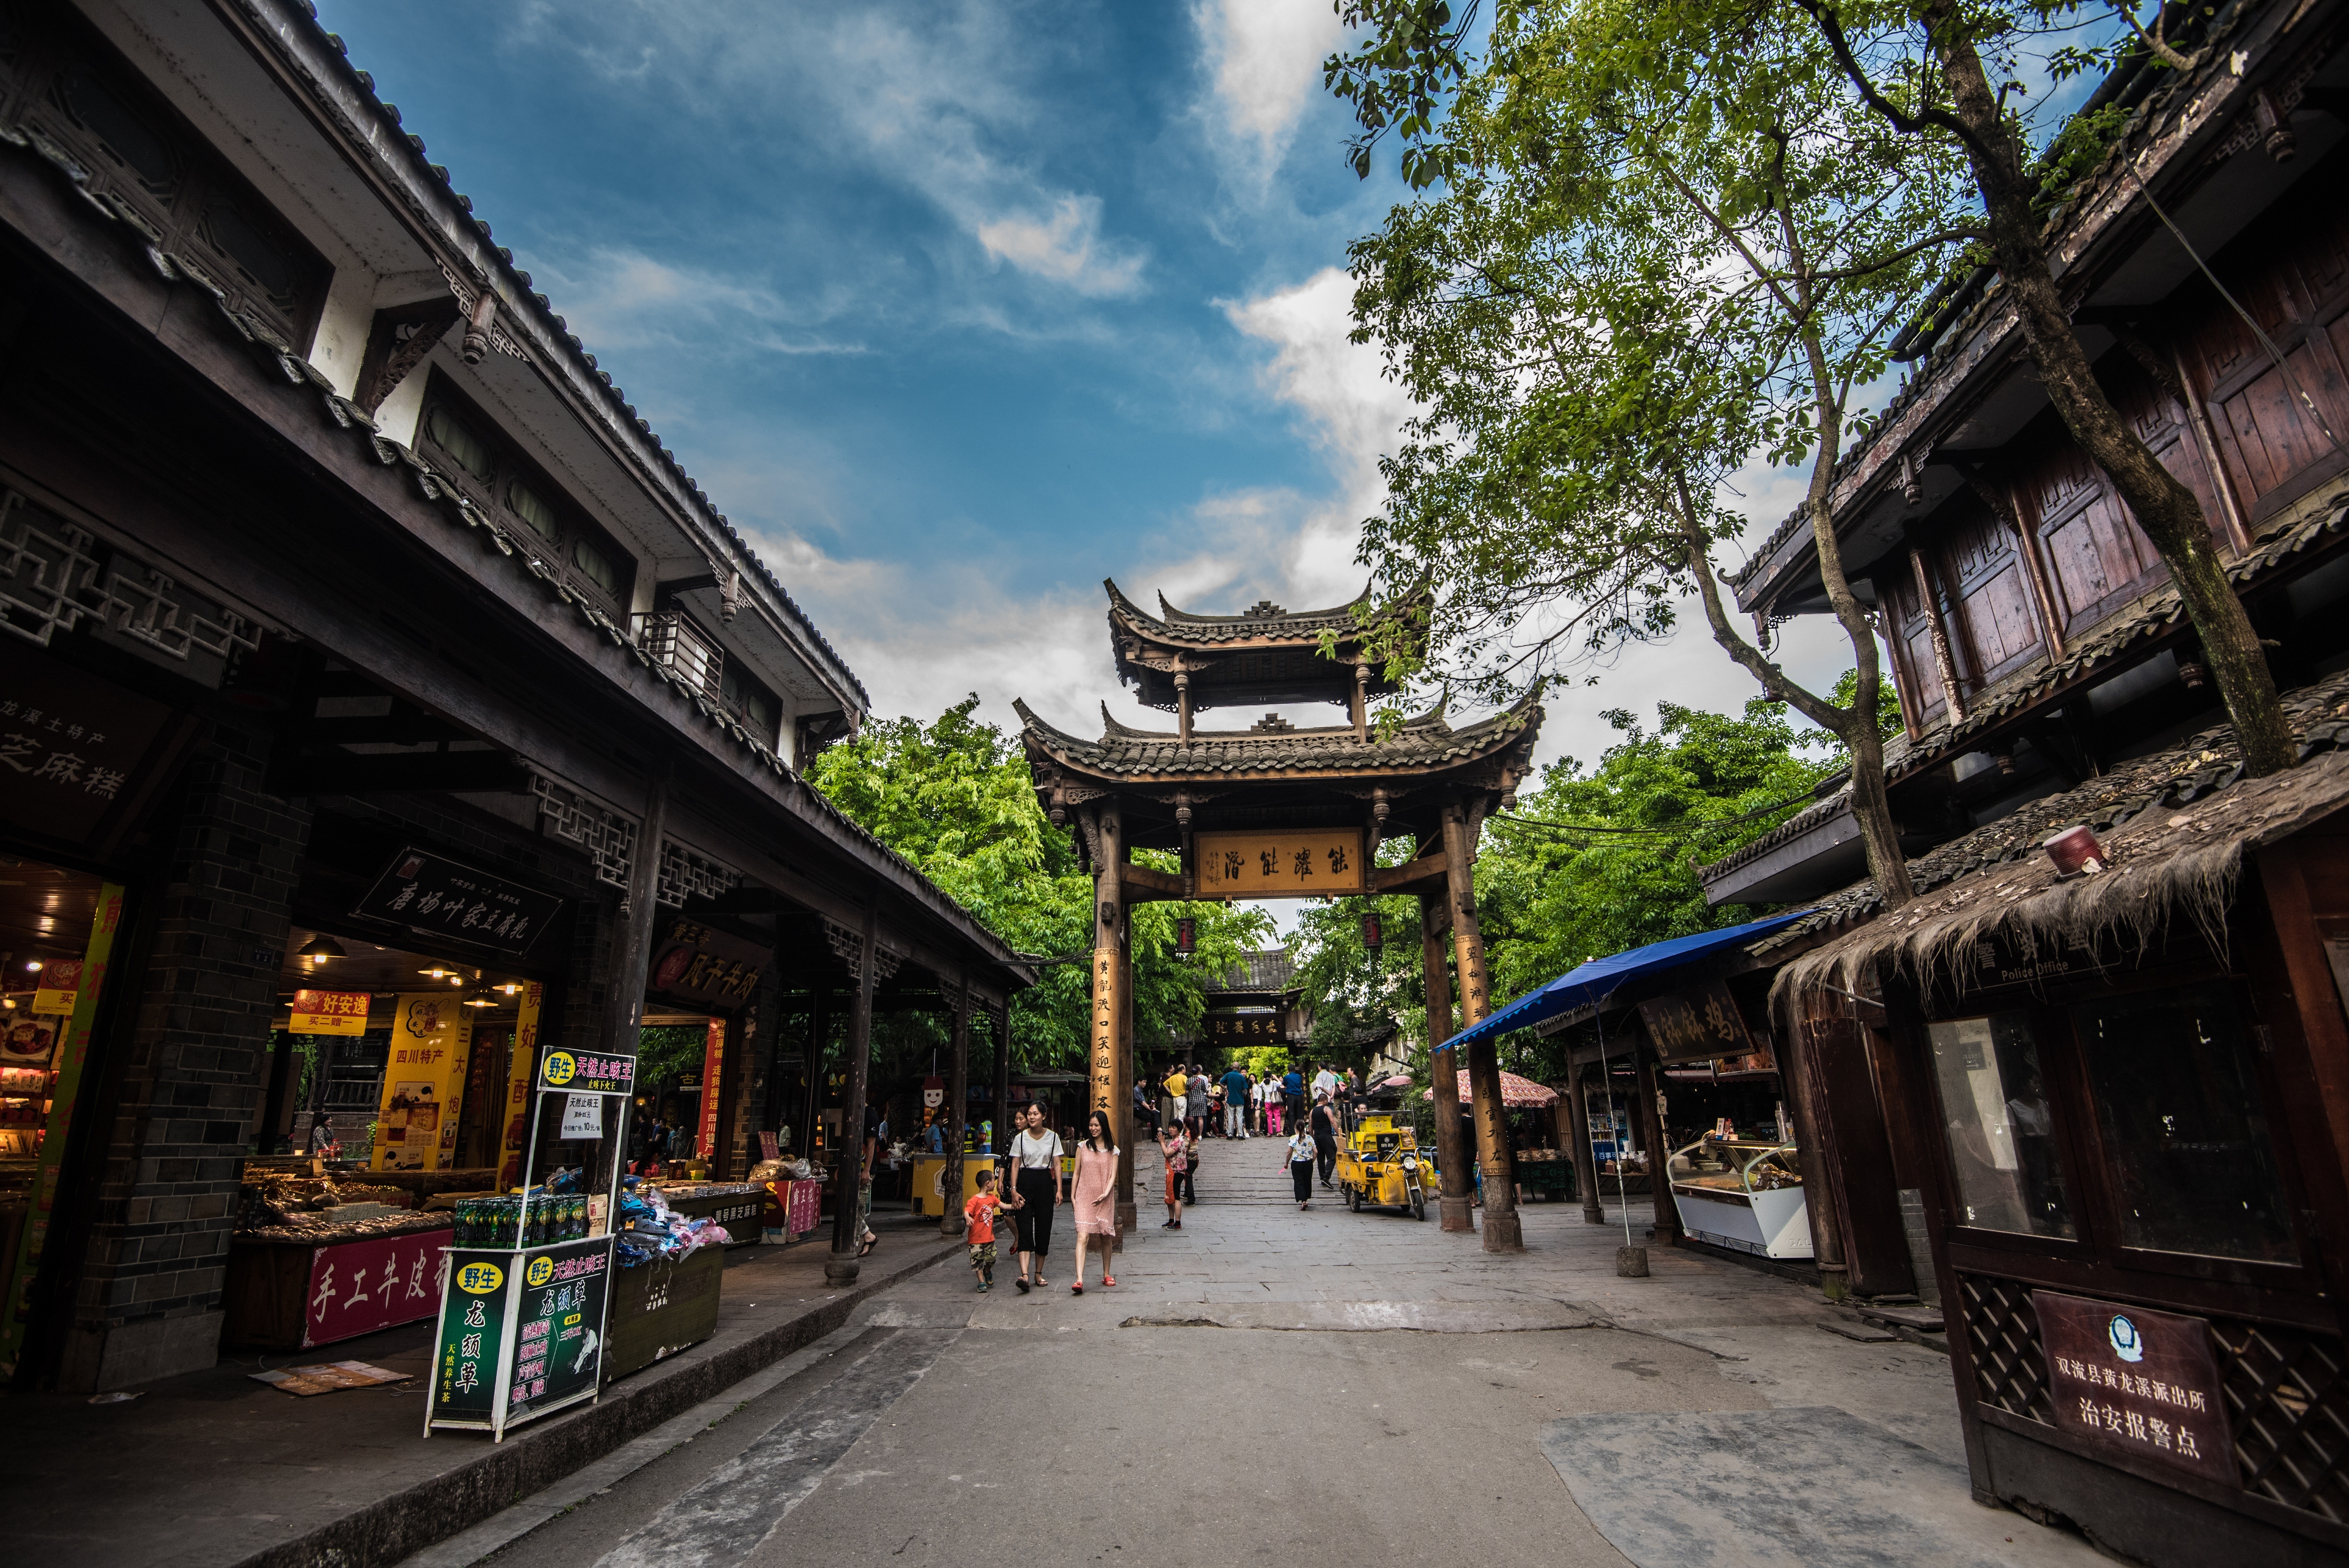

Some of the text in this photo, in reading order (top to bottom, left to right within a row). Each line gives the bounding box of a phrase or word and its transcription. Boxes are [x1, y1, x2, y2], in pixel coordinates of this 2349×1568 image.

[2001, 961, 2069, 982] Police Office
[322, 993, 368, 1015] 好安逸
[308, 1016, 353, 1027] 买二赠一
[396, 1048, 444, 1064] 四川特产
[447, 1027, 470, 1114] 三大炮
[548, 1056, 632, 1080] 野生 天然止咳王
[587, 1079, 616, 1091] 止咳下火王
[568, 1097, 599, 1108] 天然止咳王
[463, 1267, 496, 1289] 野生
[530, 1252, 607, 1284] 野生 天然止咳王
[540, 1279, 586, 1317] 龙须草
[522, 1319, 550, 1341] 清热解毒
[455, 1300, 486, 1394] 龙须草
[520, 1340, 548, 1361] 润肺止咳
[441, 1343, 456, 1403] 天然养生茶
[517, 1359, 545, 1382] 声音沙哑
[2055, 1356, 2206, 1414] 双流县黄龙溪派出所
[2078, 1397, 2201, 1460] 治安报警点
